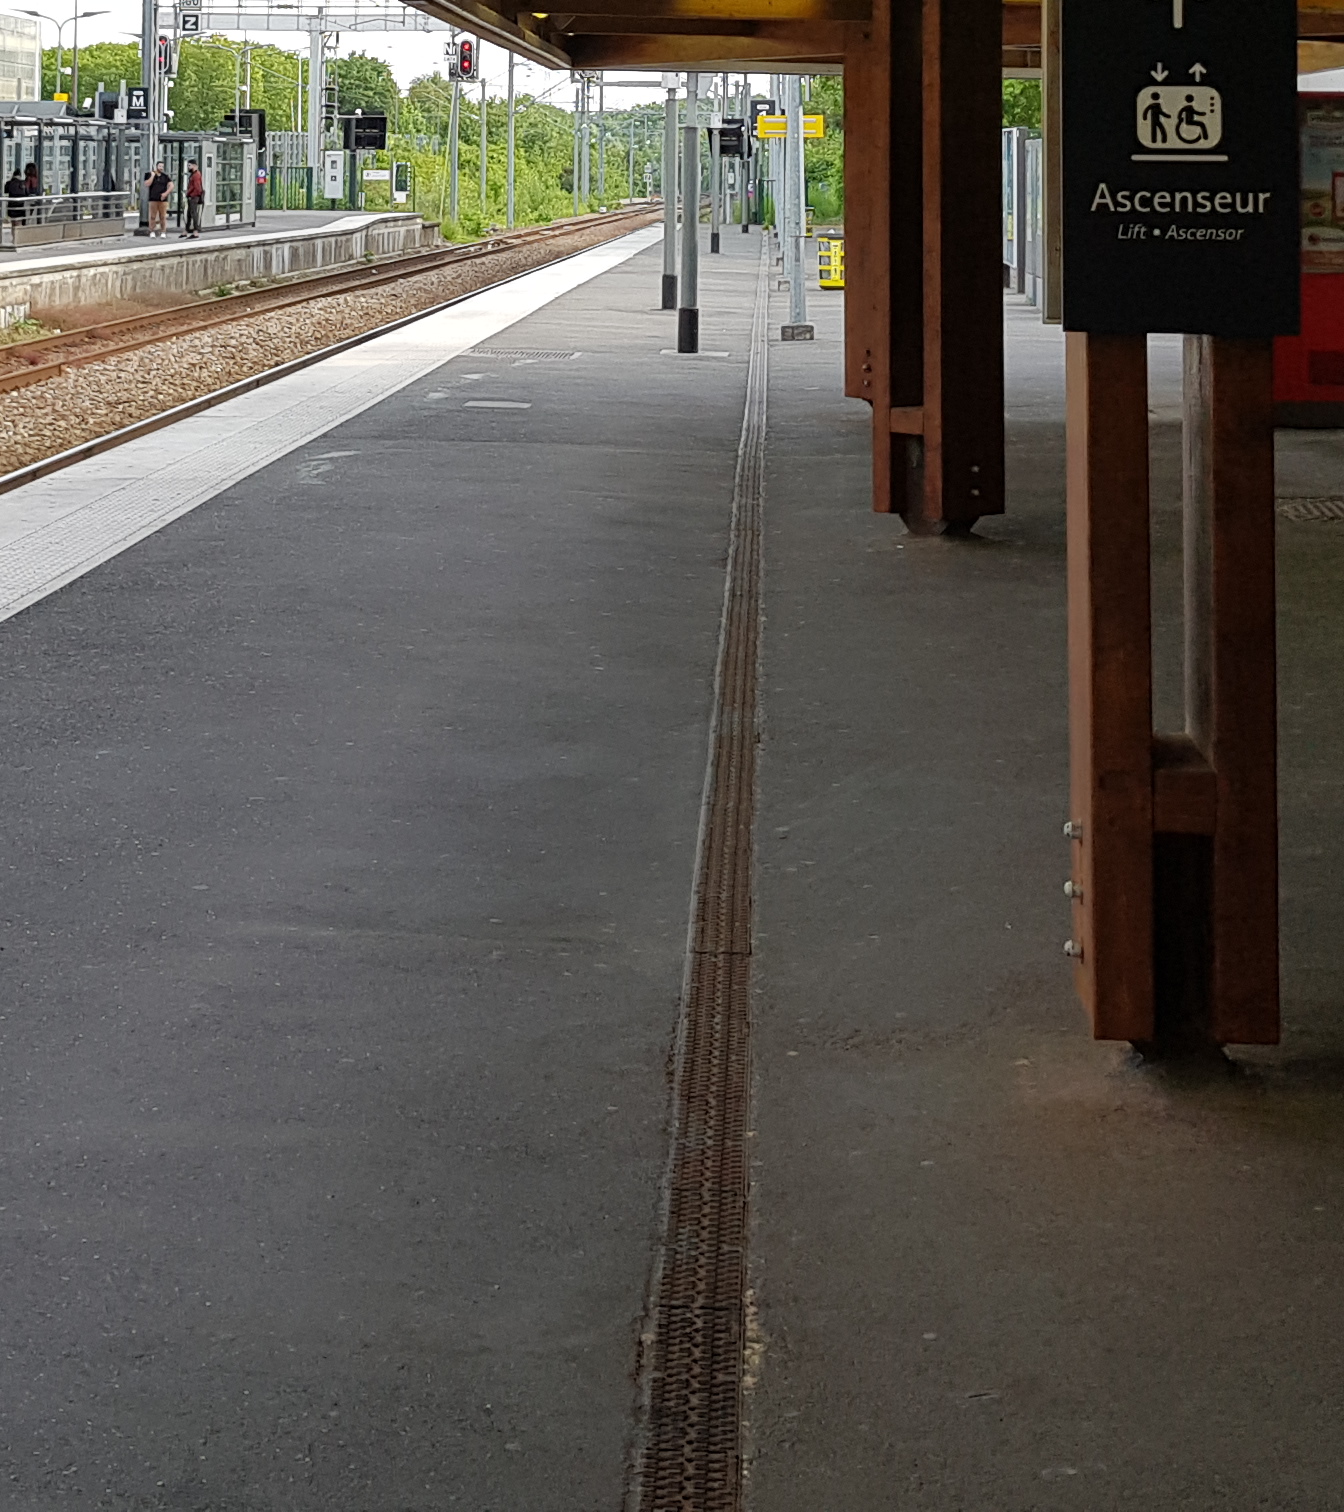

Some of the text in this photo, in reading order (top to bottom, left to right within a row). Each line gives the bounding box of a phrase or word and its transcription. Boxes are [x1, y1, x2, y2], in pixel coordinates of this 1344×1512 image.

[184, 16, 197, 29] Z
[132, 96, 144, 107] M
[1090, 182, 1271, 213] Ascenseur
[1117, 223, 1244, 240] Lift Ascensor
